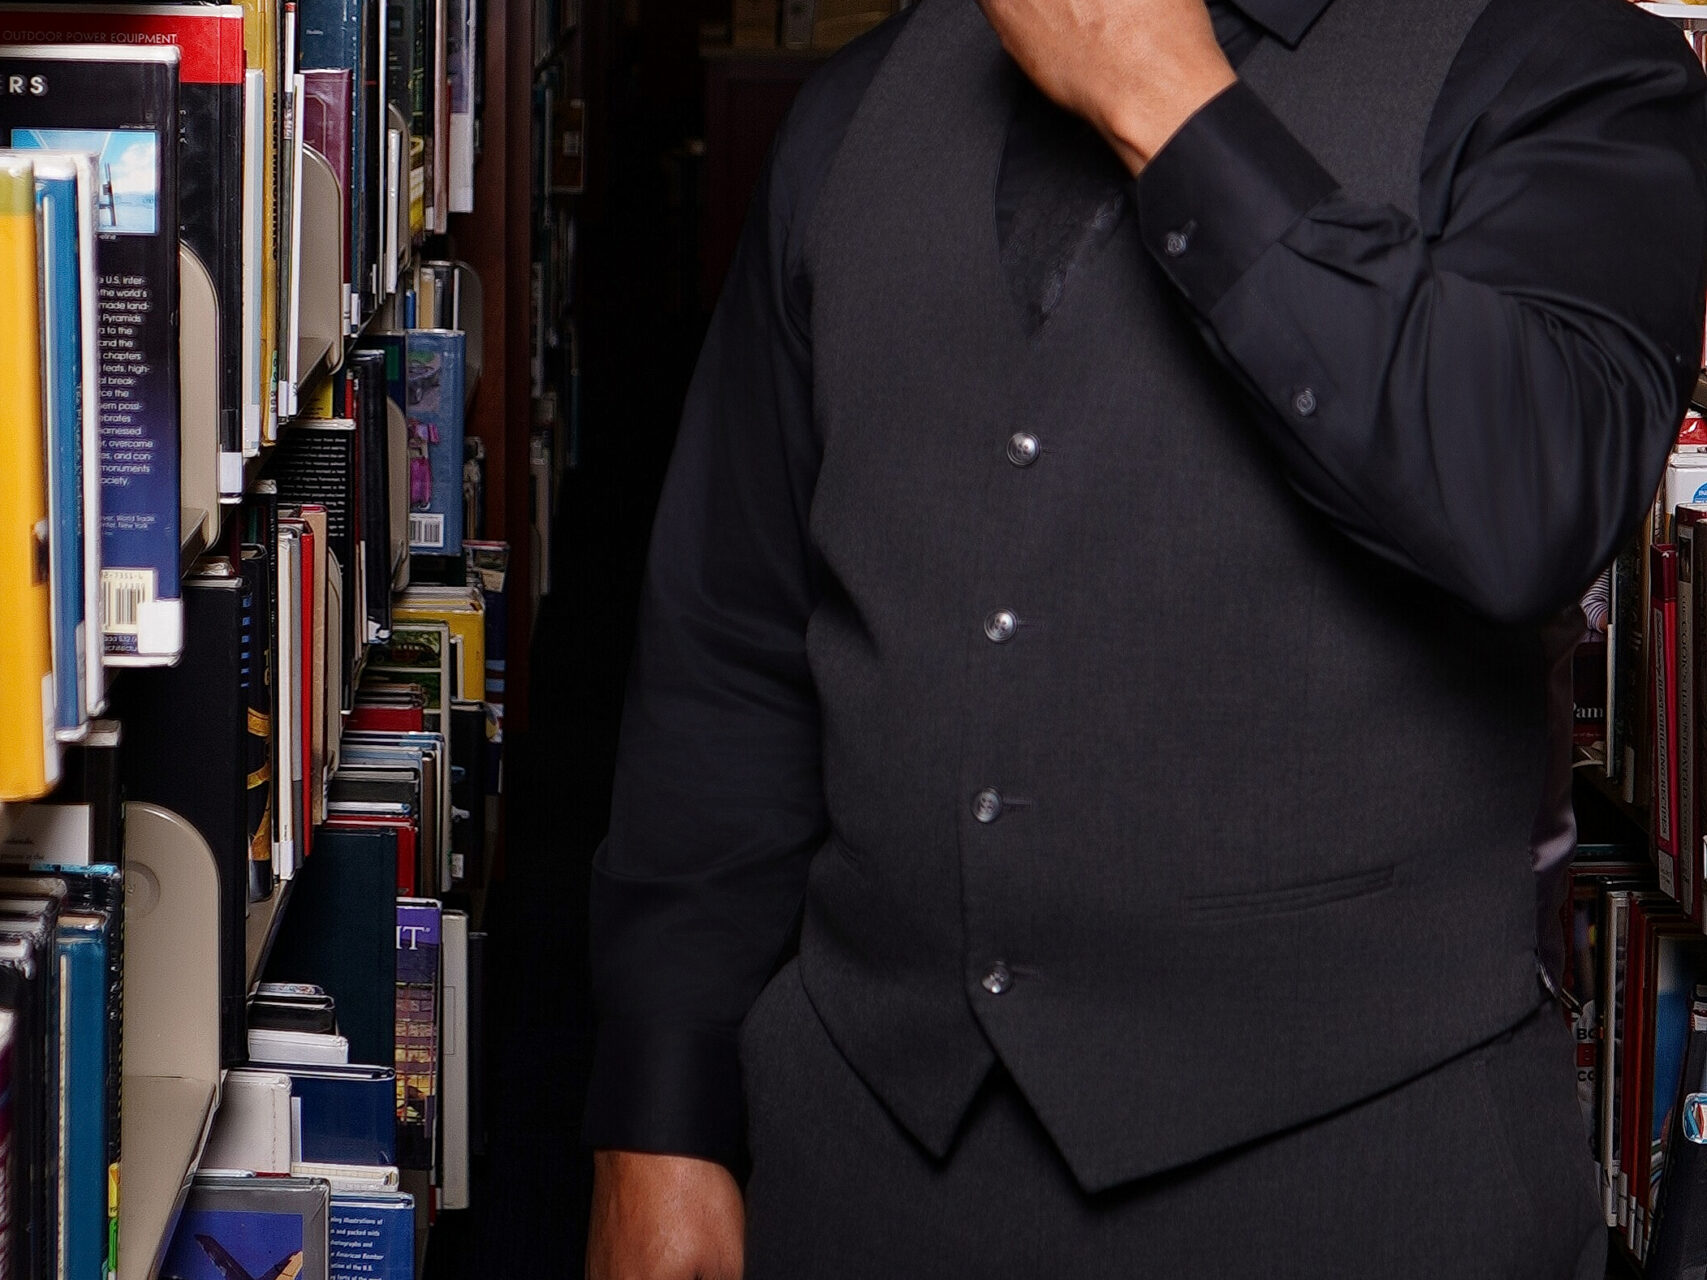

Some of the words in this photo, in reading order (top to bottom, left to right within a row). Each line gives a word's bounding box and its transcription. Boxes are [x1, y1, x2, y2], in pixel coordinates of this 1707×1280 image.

[3, 31, 63, 41] OUTDOOR
[66, 32, 106, 42] POWER
[111, 33, 177, 44] EQUIPMENT
[123, 276, 145, 285] inter-
[103, 314, 142, 323] Pyramids
[103, 352, 142, 361] chapters
[128, 364, 150, 374] high-
